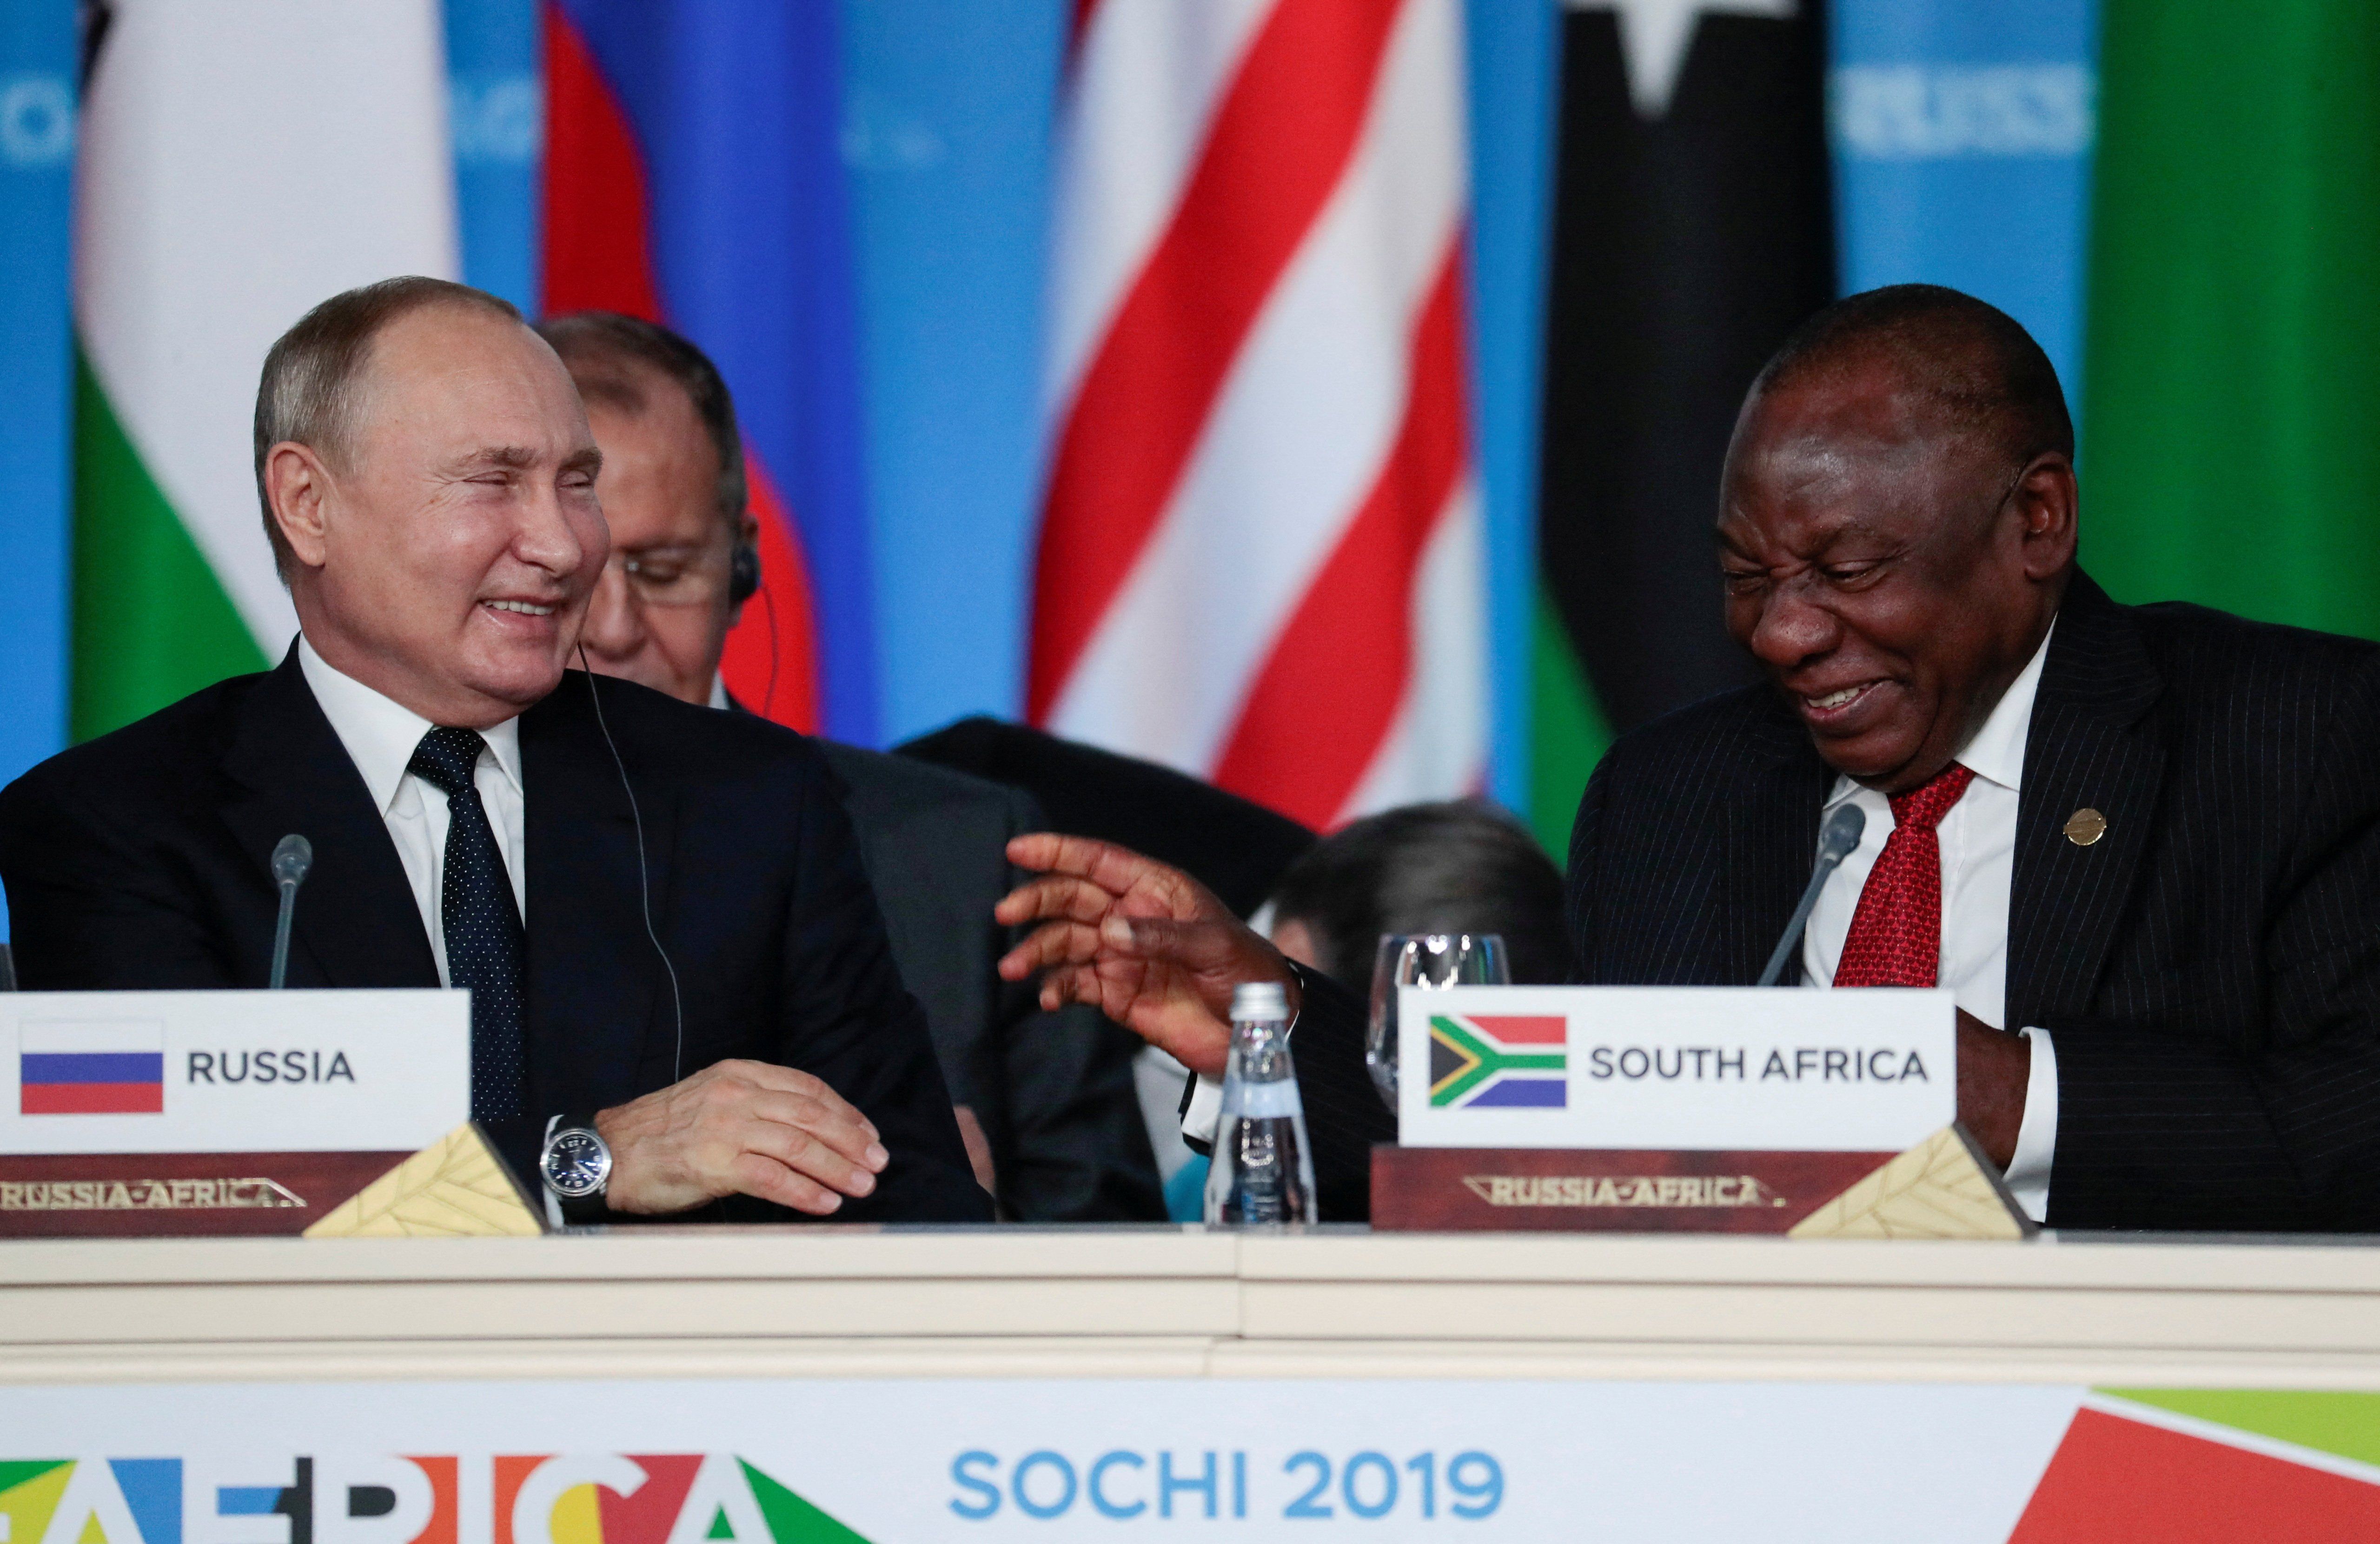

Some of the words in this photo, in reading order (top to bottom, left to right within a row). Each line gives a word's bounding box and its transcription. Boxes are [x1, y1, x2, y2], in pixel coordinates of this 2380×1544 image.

[188, 1050, 355, 1083] RUSSIA
[1591, 1047, 1745, 1080] SOUTH
[1761, 1049, 1929, 1081] AFRICA
[1, 1180, 274, 1209] RUSSIA-AFRICA
[1490, 1176, 1763, 1206] RUSSIA-AFRICA
[949, 1450, 1247, 1520] SOCHI
[1282, 1450, 1504, 1520] 2019
